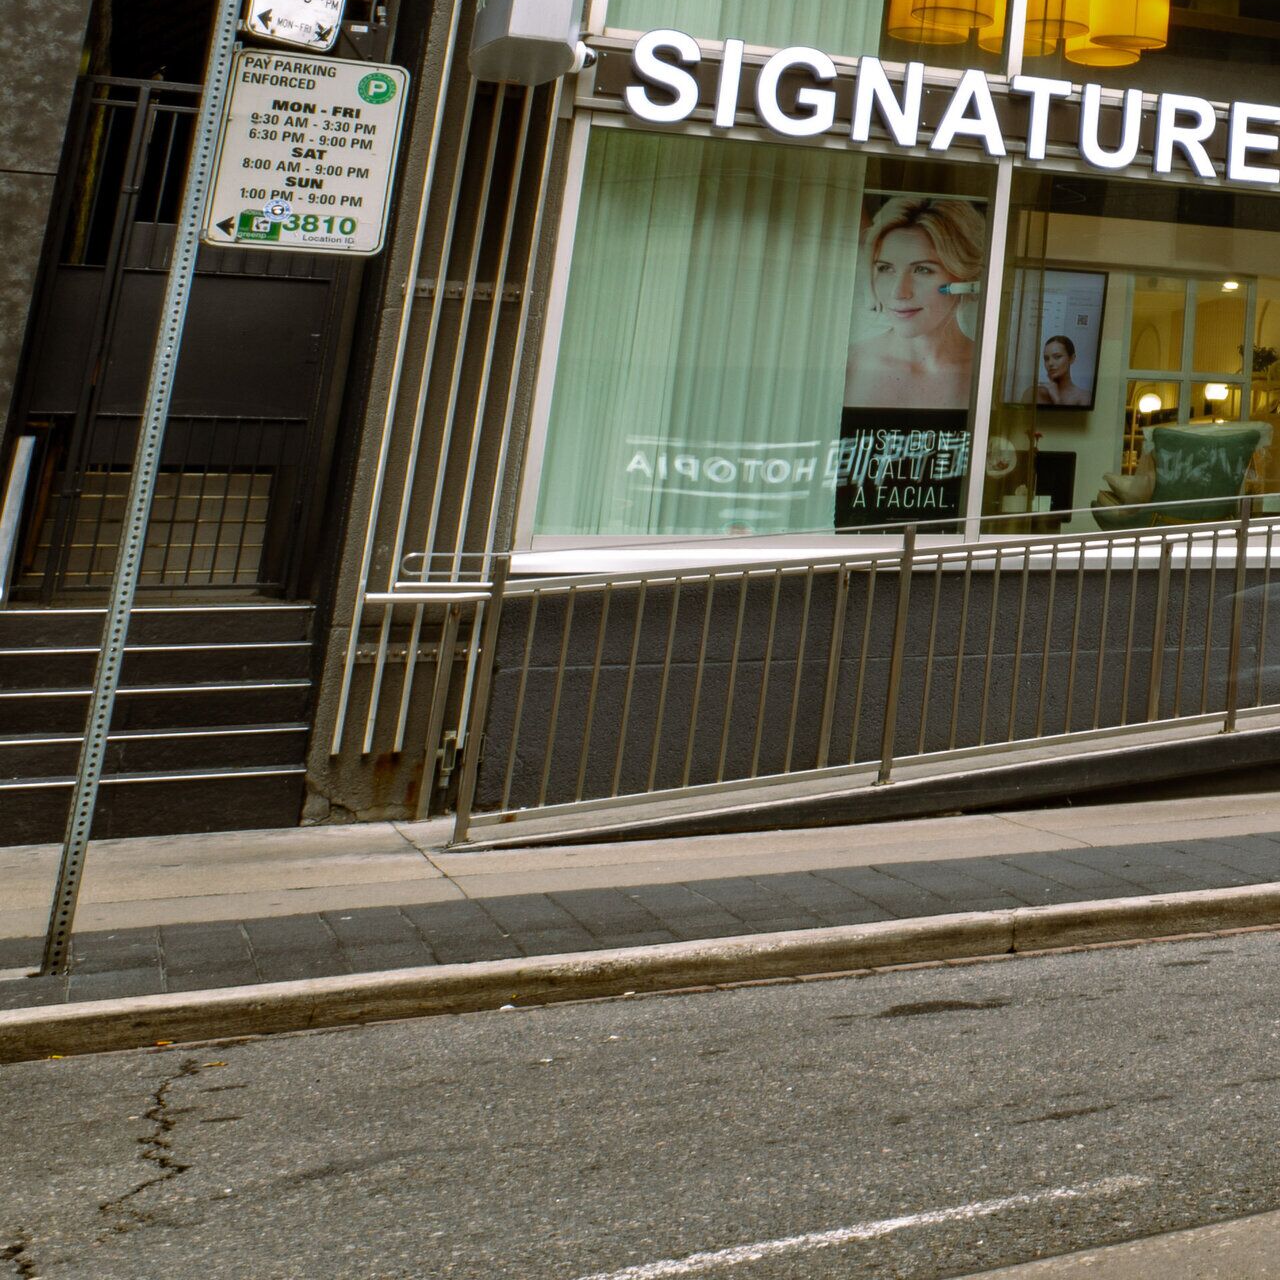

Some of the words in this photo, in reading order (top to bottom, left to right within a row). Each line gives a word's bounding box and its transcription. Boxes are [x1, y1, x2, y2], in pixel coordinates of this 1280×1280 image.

[244, 56, 272, 70] PAY
[274, 59, 337, 78] PARKING
[242, 71, 316, 91] ENFORCED
[272, 99, 316, 114] MON
[332, 106, 361, 119] FRI
[283, 117, 308, 129] AM
[322, 120, 350, 132] 3:30
[354, 122, 376, 135] PM
[249, 128, 277, 142] 6:30
[281, 131, 305, 144] PM
[318, 134, 347, 148] 9:00
[350, 137, 373, 150] PM
[291, 147, 327, 160] SAT
[242, 157, 271, 170] 8:00
[276, 161, 300, 173] AM
[315, 164, 343, 177] 9:00
[347, 167, 369, 179] PM
[285, 176, 324, 189] SUN
[240, 187, 266, 200] 1:00
[270, 189, 293, 202] PM
[307, 193, 336, 206] 9:00
[340, 195, 363, 207] PM
[282, 213, 357, 235] 3810
[302, 234, 343, 244] Location
[854, 428, 902, 453] JUST
[867, 457, 920, 480] CALL
[853, 486, 866, 509] A
[876, 485, 956, 509] FACIAL.
